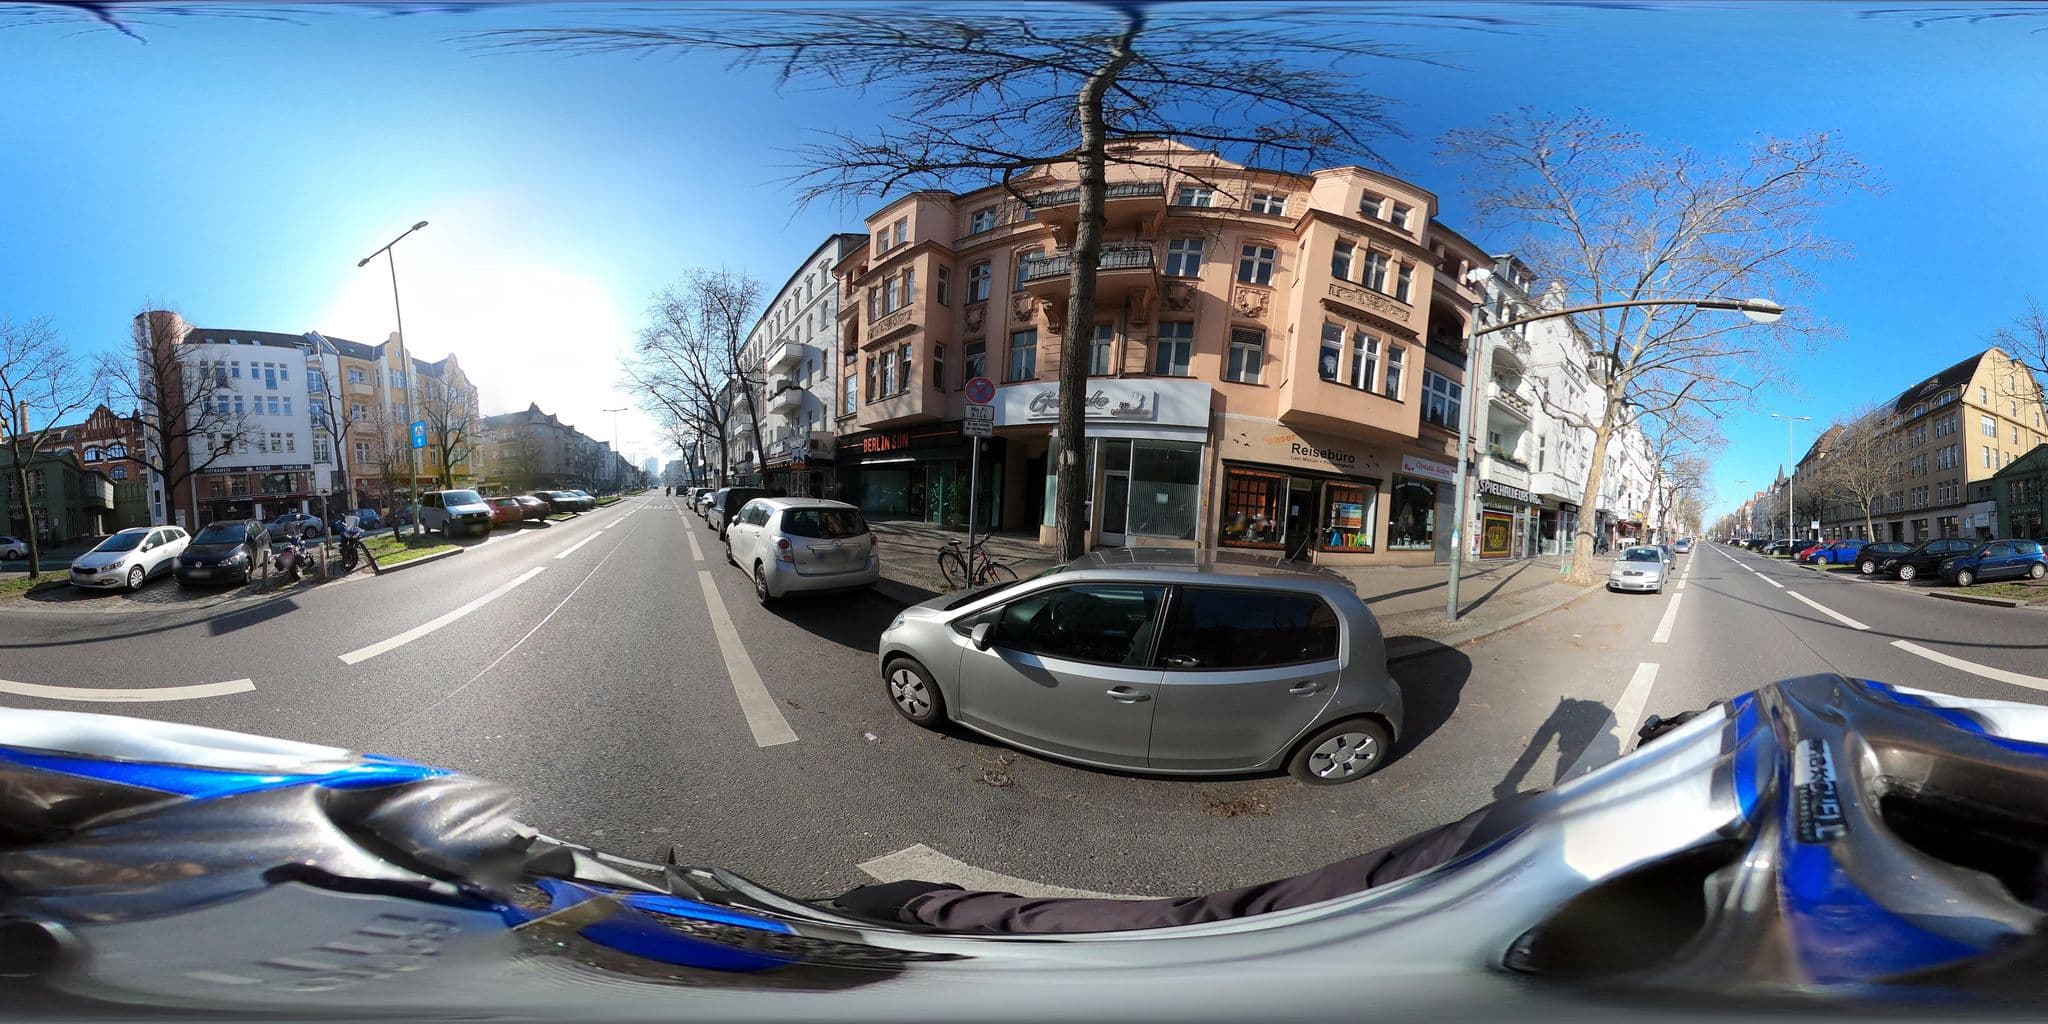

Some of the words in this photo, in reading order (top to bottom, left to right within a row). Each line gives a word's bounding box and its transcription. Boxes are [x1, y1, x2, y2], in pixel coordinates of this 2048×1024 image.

[863, 435, 890, 453] BERLIN
[891, 432, 909, 450] SUN
[1479, 480, 1519, 501] SPIELHALLE
